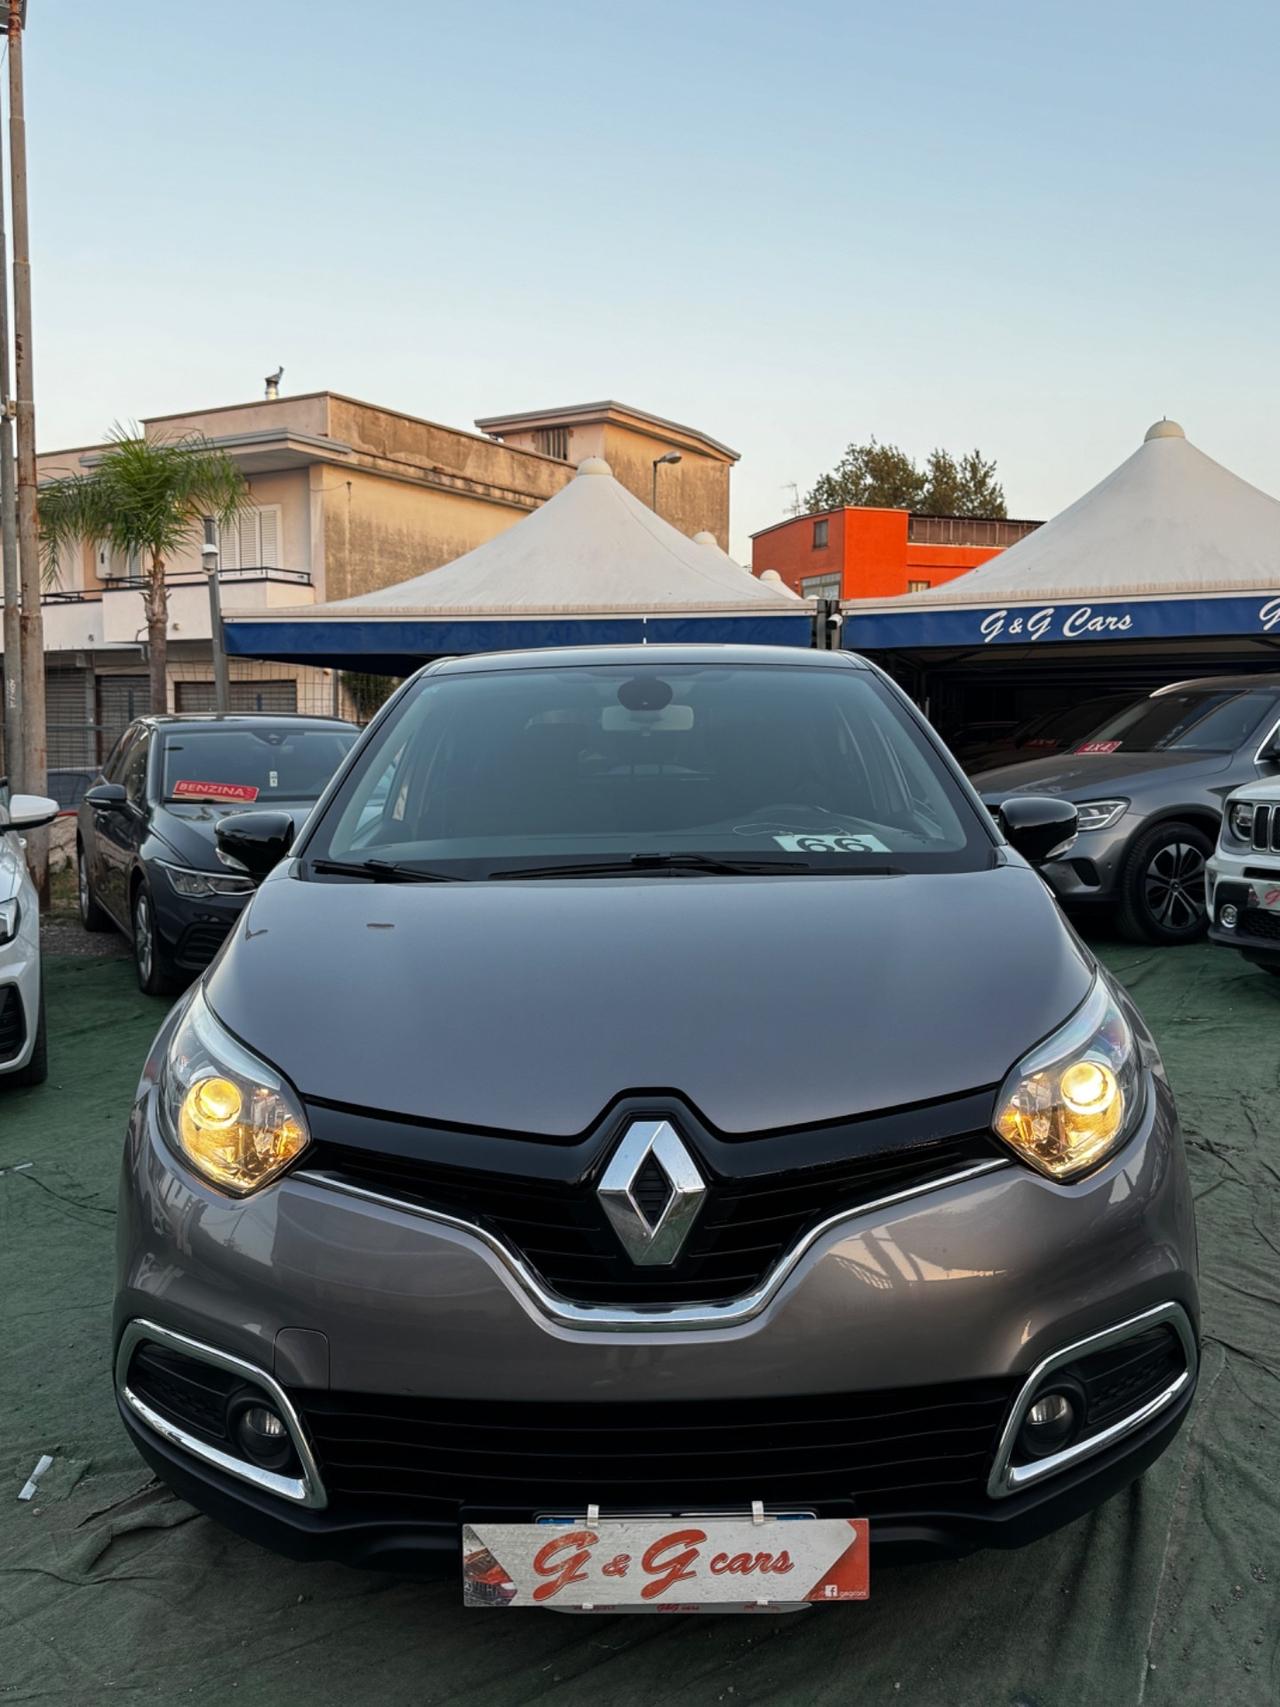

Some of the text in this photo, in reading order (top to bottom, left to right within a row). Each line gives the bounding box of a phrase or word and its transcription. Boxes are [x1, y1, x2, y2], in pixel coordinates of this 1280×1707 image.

[1062, 607, 1133, 638] Cars
[179, 783, 245, 796] BENZINA
[532, 1528, 796, 1602] G & G cars
